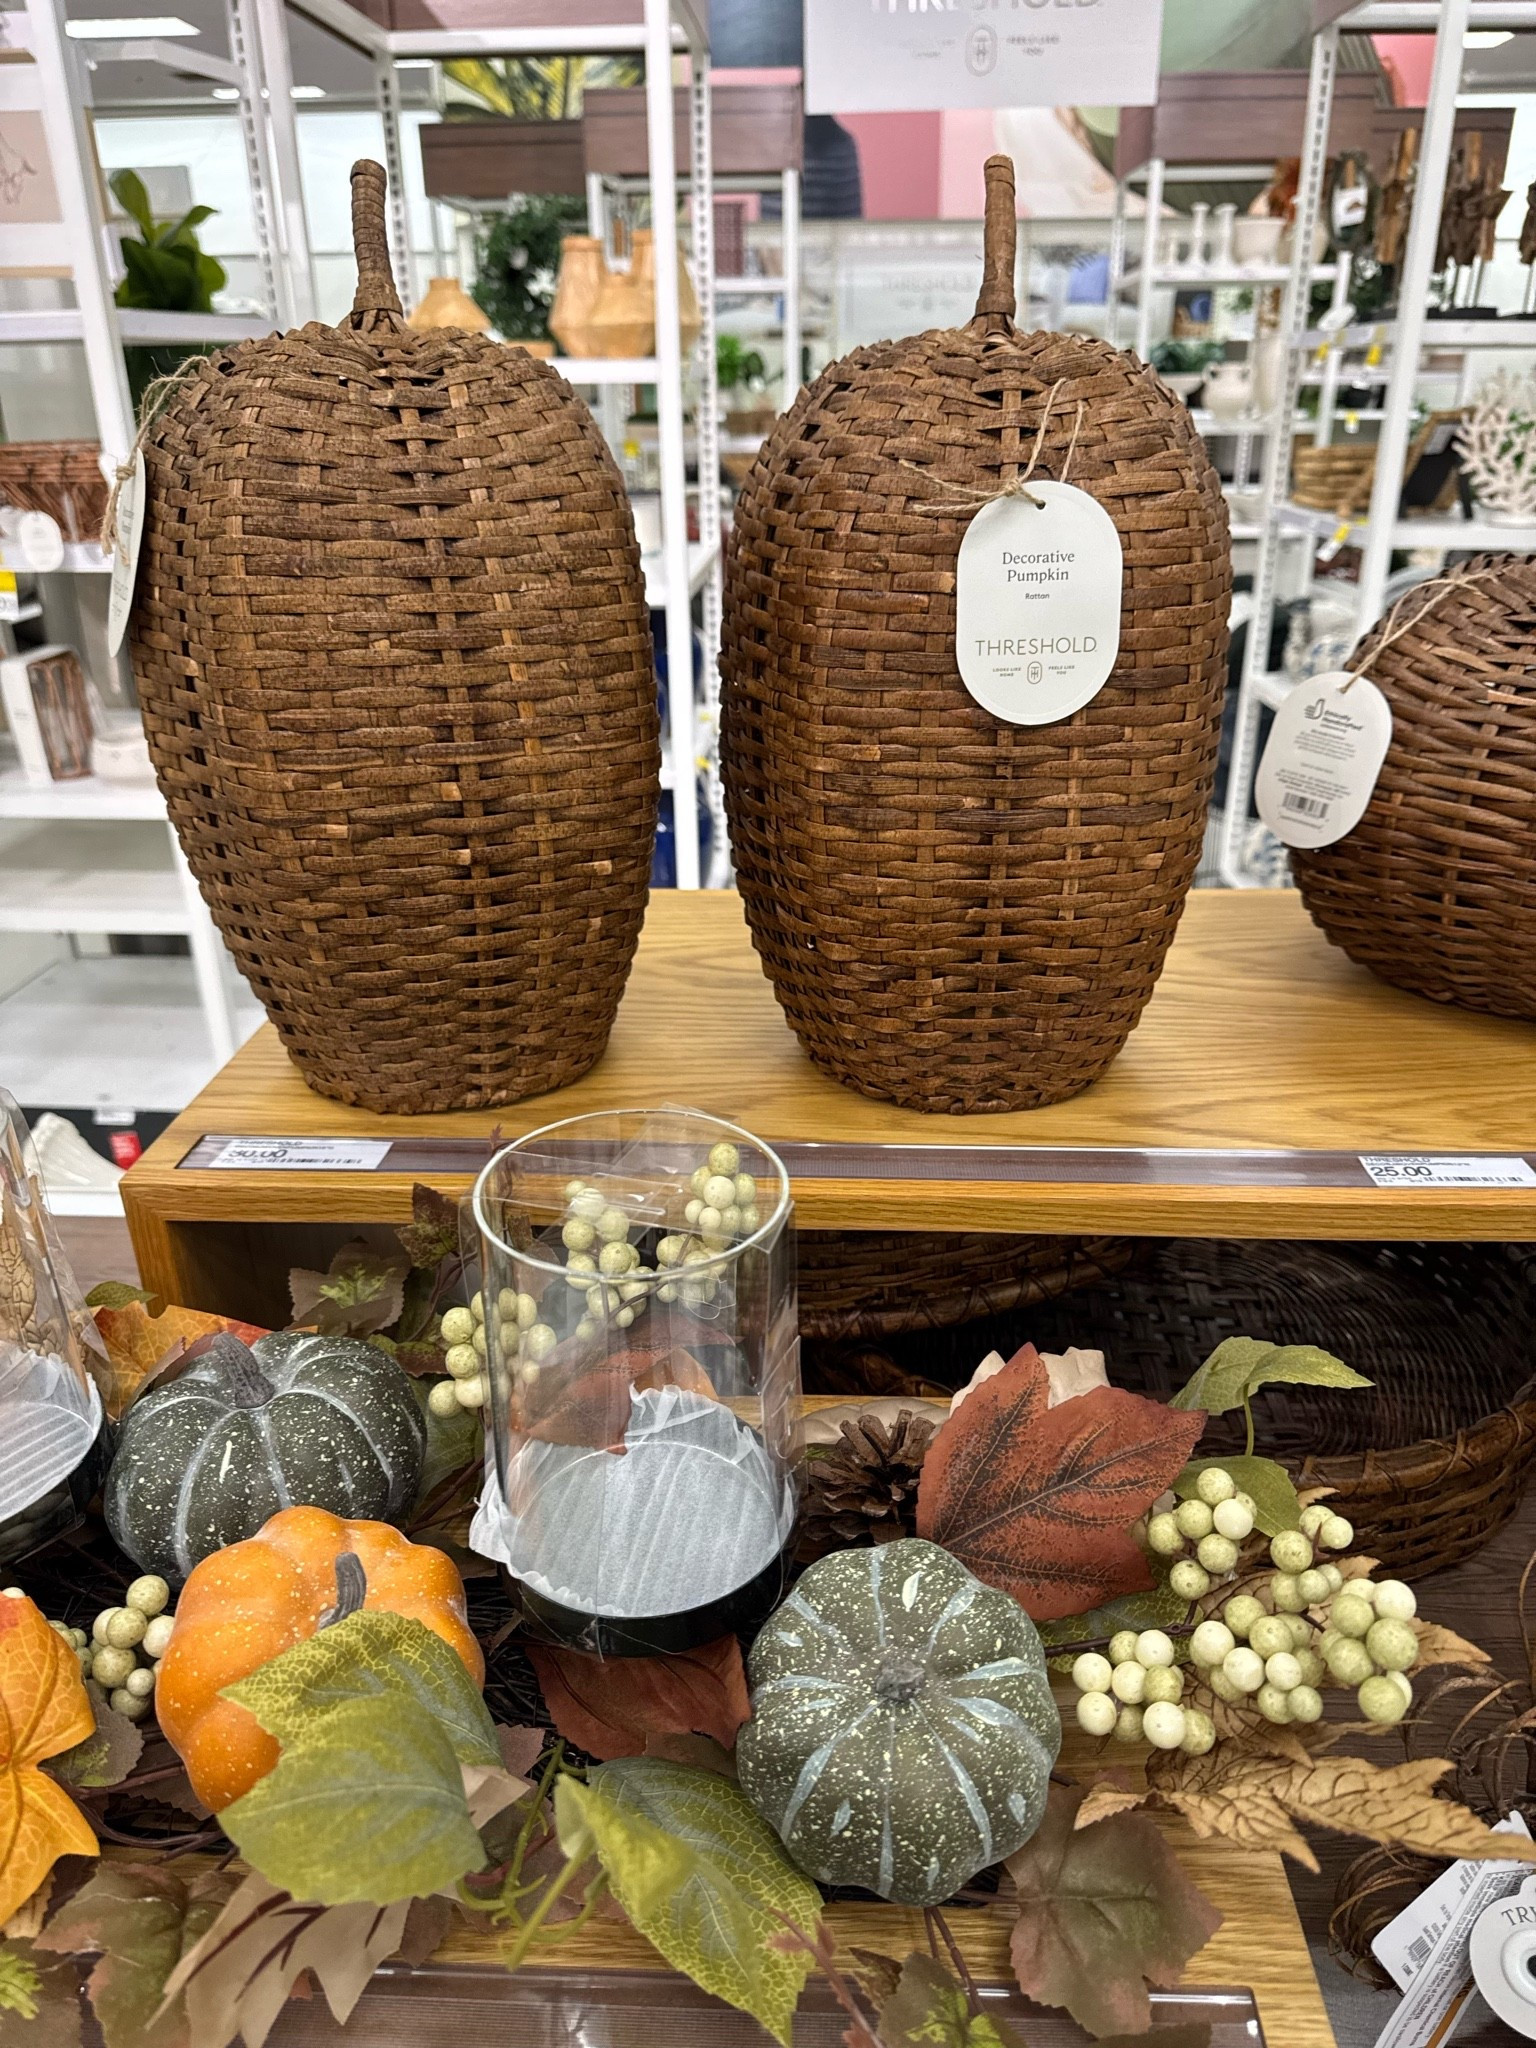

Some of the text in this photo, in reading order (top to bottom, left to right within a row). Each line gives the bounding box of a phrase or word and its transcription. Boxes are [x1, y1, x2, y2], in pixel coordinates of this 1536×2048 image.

[1002, 550, 1076, 565] Decorative
[1007, 568, 1070, 585] Pumpkin
[1025, 592, 1050, 600] Rattan
[975, 636, 1098, 656] THRESHOLD
[1370, 1166, 1432, 1177] 25.00
